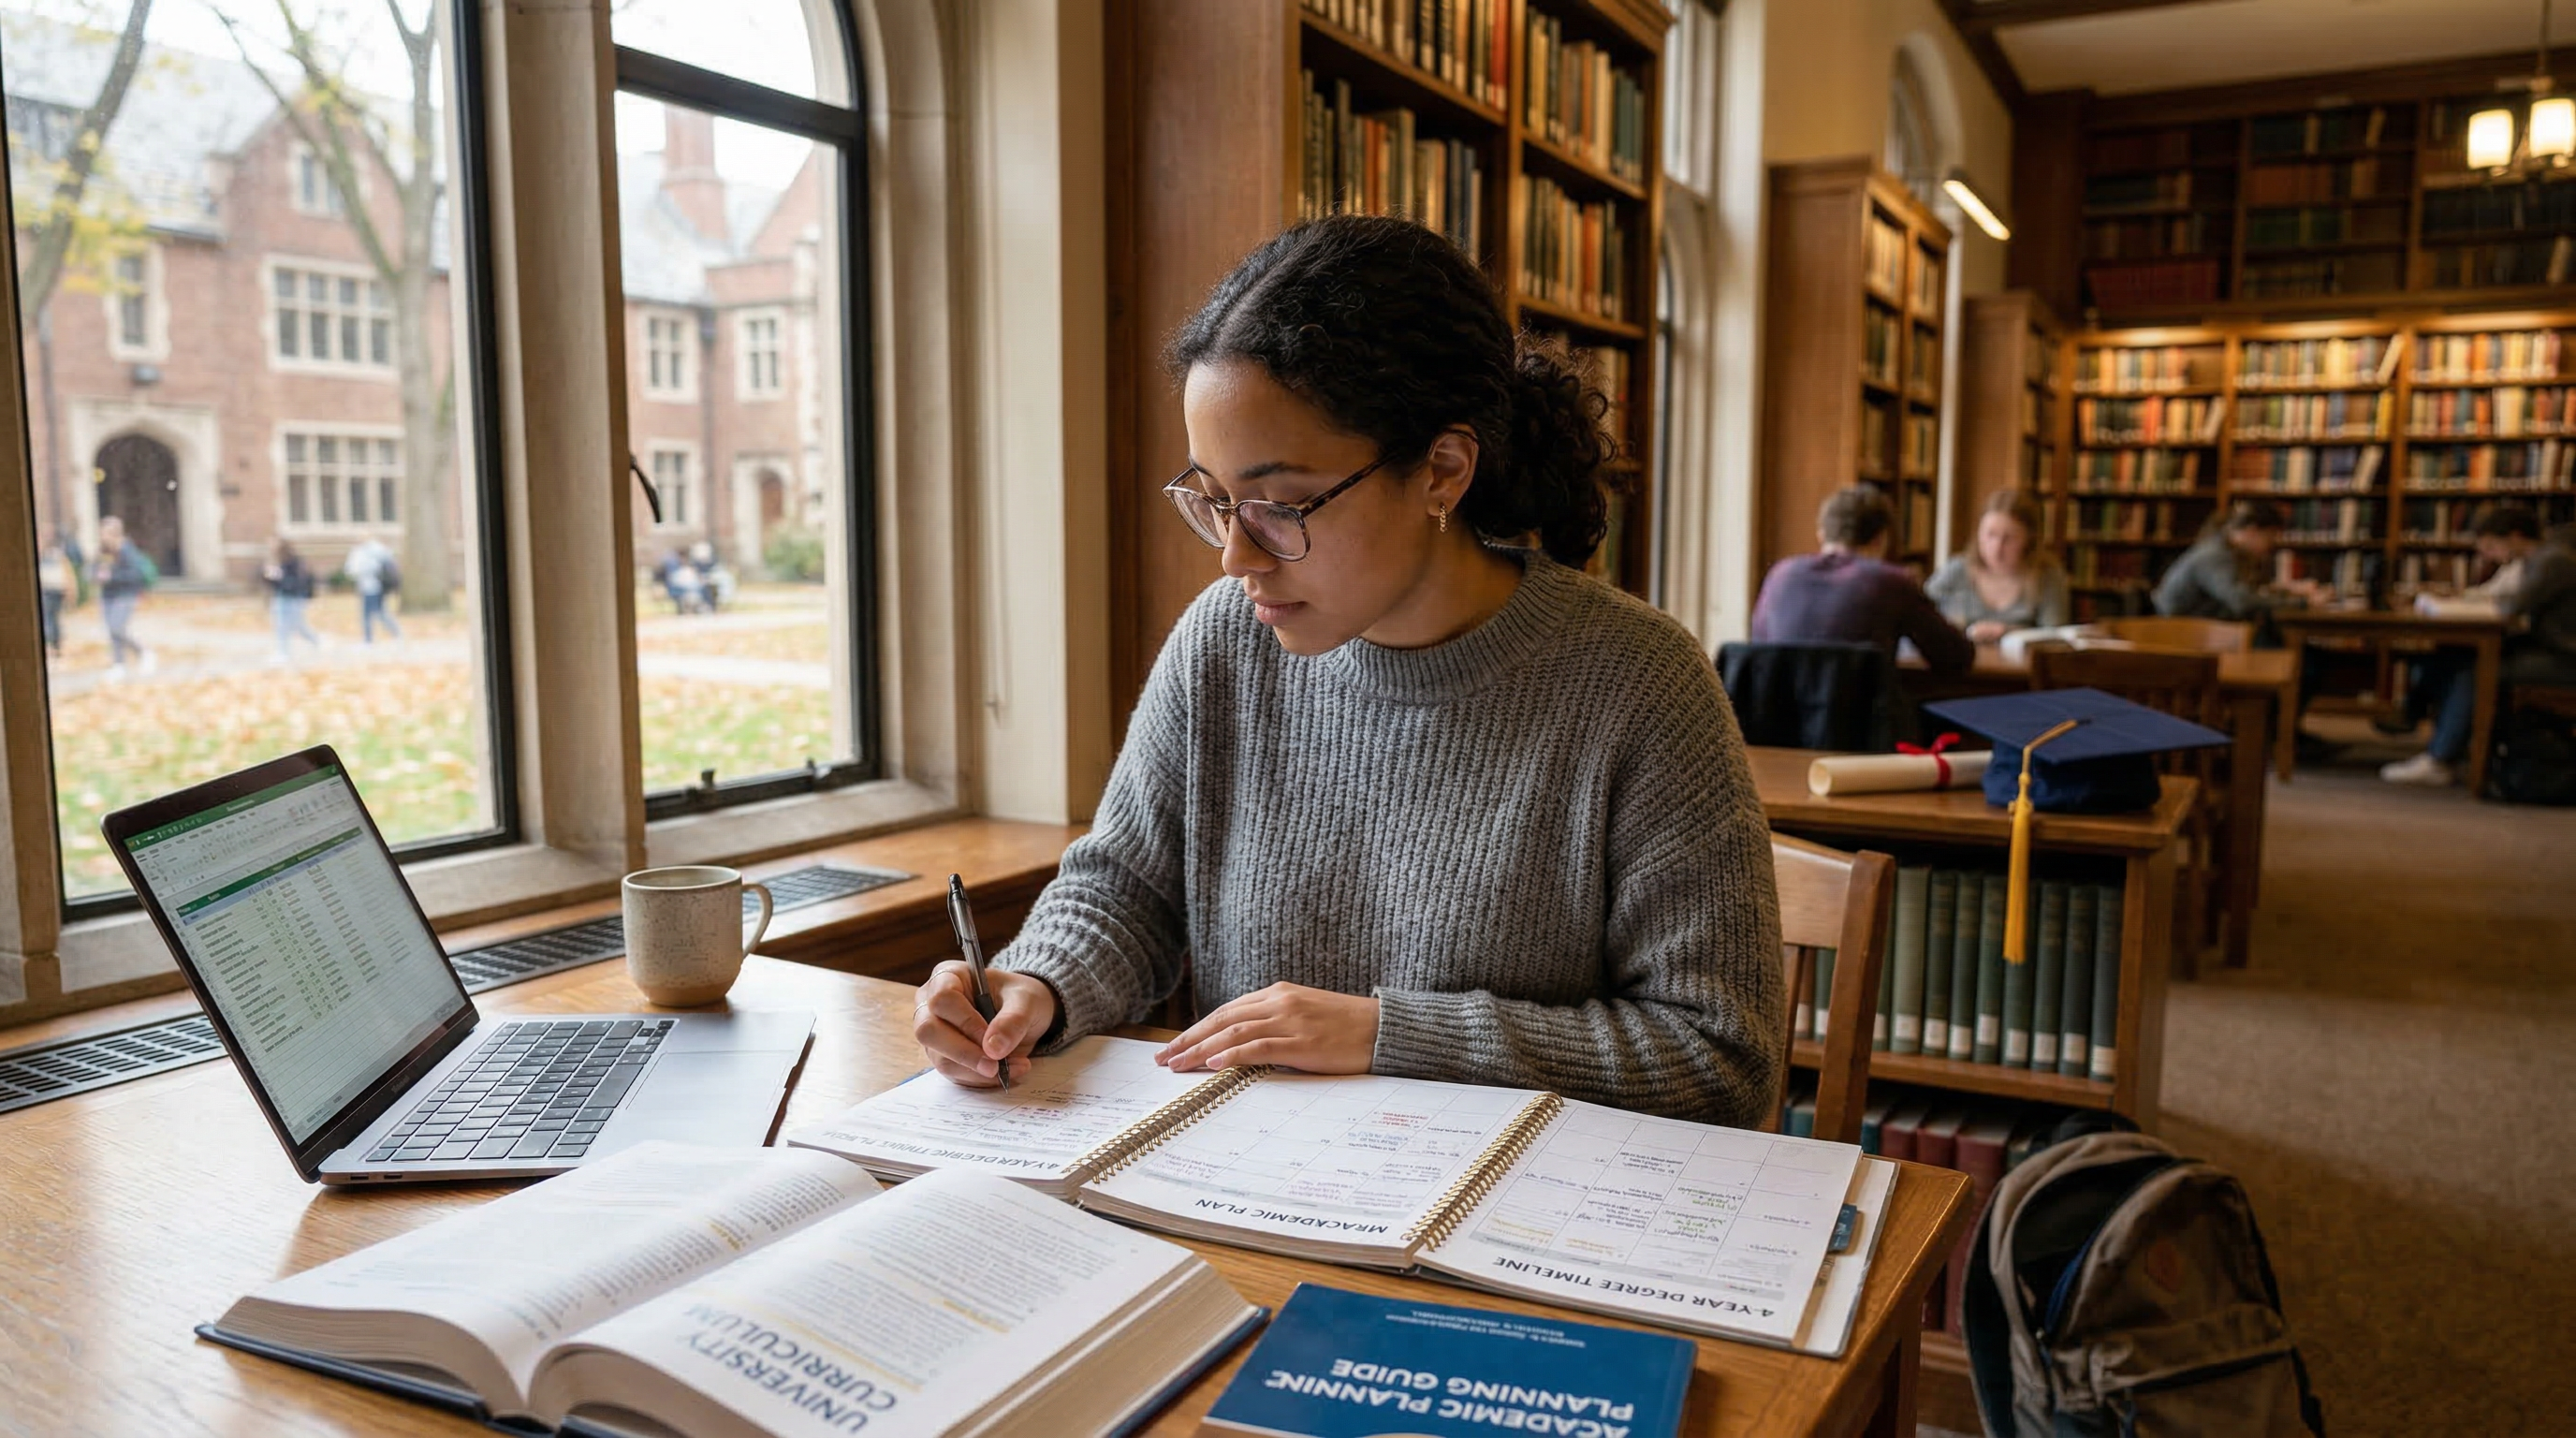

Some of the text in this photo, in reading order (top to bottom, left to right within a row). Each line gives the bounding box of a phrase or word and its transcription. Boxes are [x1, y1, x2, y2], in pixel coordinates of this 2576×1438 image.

[1195, 1198, 1248, 1214] PLAN
[1492, 1256, 1775, 1317] 4-YEAR DEGREE TIMELINE
[683, 1330, 870, 1433] UNIVERSITY
[1329, 1358, 1635, 1420] PLANNING GUIDE
[1437, 1399, 1631, 1438] ACADEMIC
